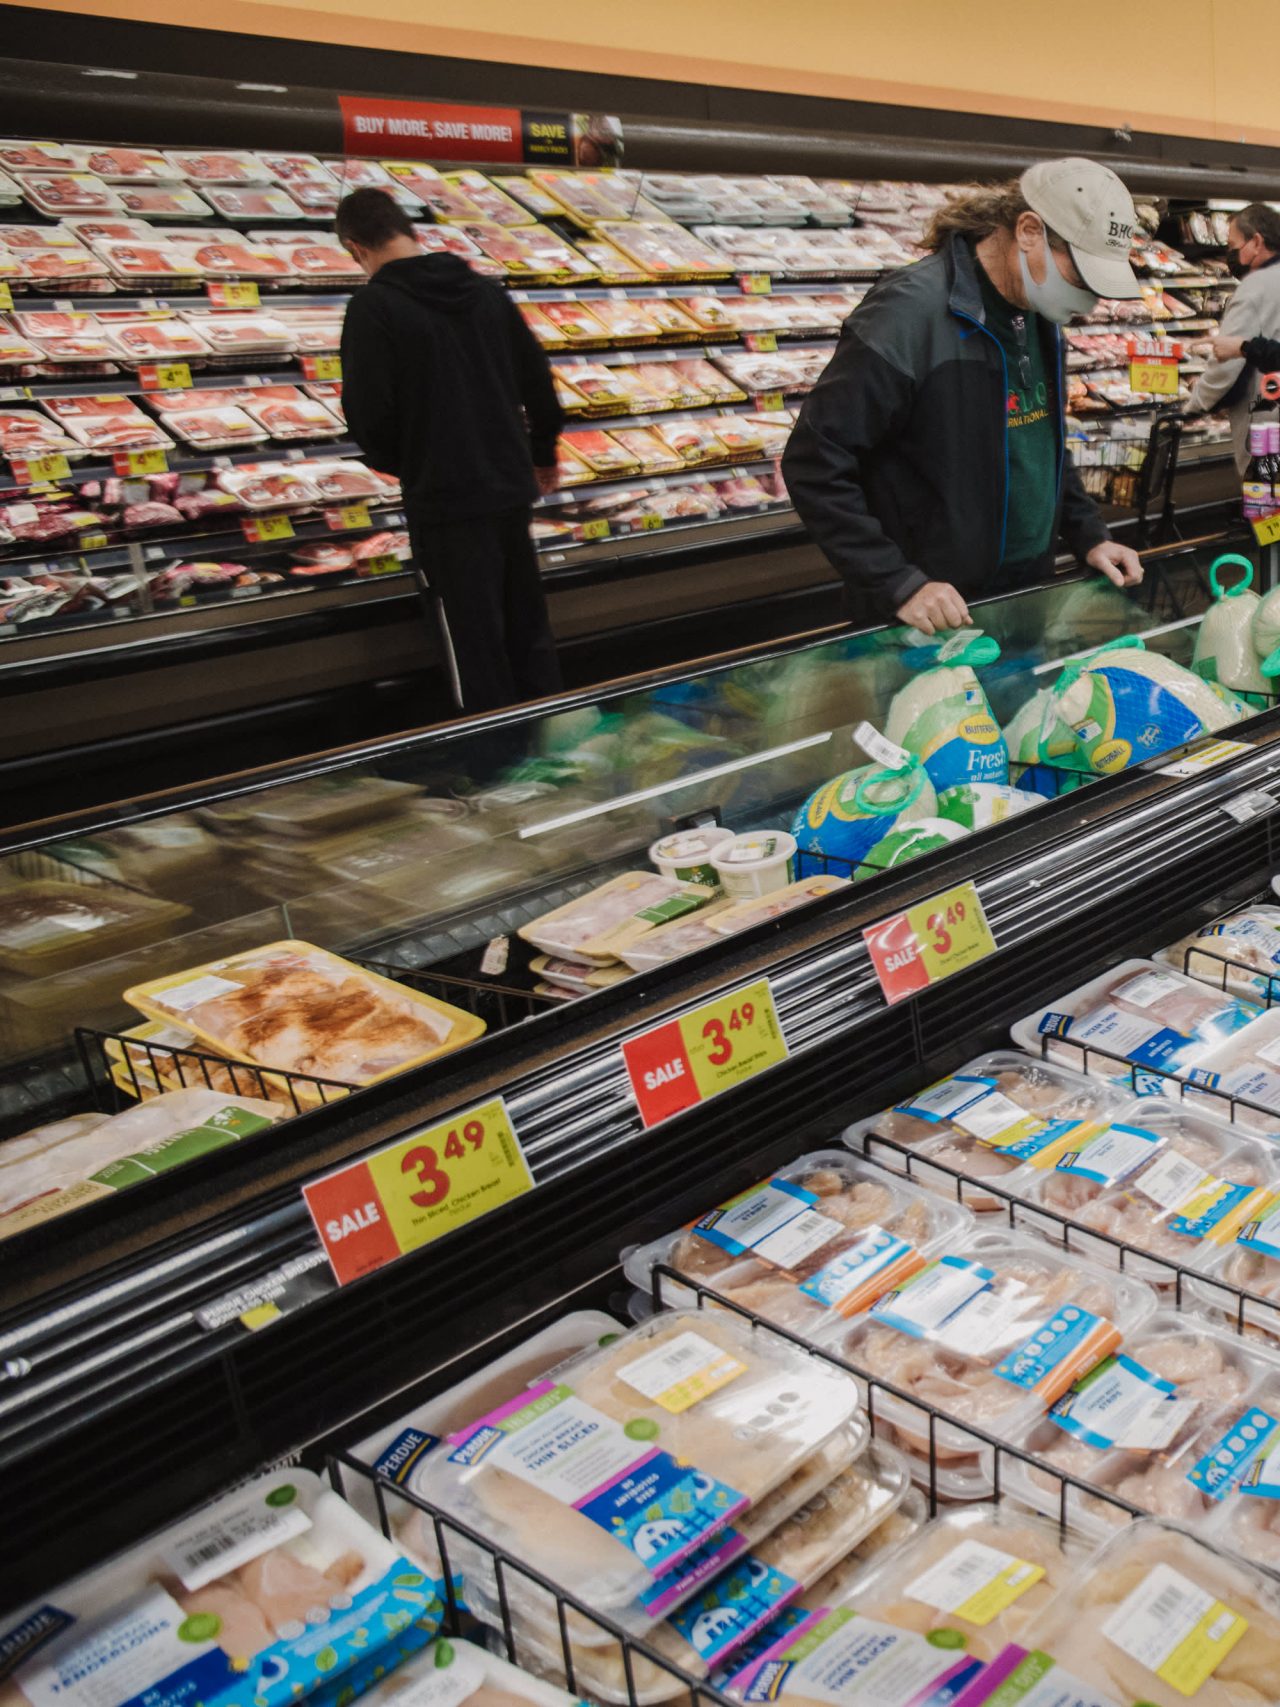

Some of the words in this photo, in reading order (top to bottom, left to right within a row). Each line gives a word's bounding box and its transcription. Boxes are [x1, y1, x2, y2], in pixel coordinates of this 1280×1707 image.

[355, 115, 385, 133] BUY
[388, 118, 432, 138] MORE,
[434, 121, 469, 139] SAVE
[472, 124, 512, 142] MORE!
[530, 122, 567, 139] SAVE
[1136, 341, 1173, 357] SALE
[1008, 408, 1049, 427] RNATIONAL
[966, 744, 1006, 771] Fresh
[884, 946, 917, 973] SALE
[1042, 1013, 1062, 1035] PERDUE
[1080, 1021, 1102, 1040] CHICKEN
[644, 1057, 685, 1090] SALE
[325, 1201, 381, 1243] SALE
[241, 1271, 287, 1301] CHICKEN
[377, 1432, 424, 1478] PERDUE
[455, 1427, 496, 1464] PERDUE
[522, 1439, 556, 1465] CHICKEN
[527, 1447, 557, 1472] THIN
[557, 1421, 600, 1454] SLICED
[615, 1473, 660, 1508] ANTIBIOTICS
[52, 1619, 171, 1693] TENDERLOINS
[750, 1662, 780, 1700] PERDUE
